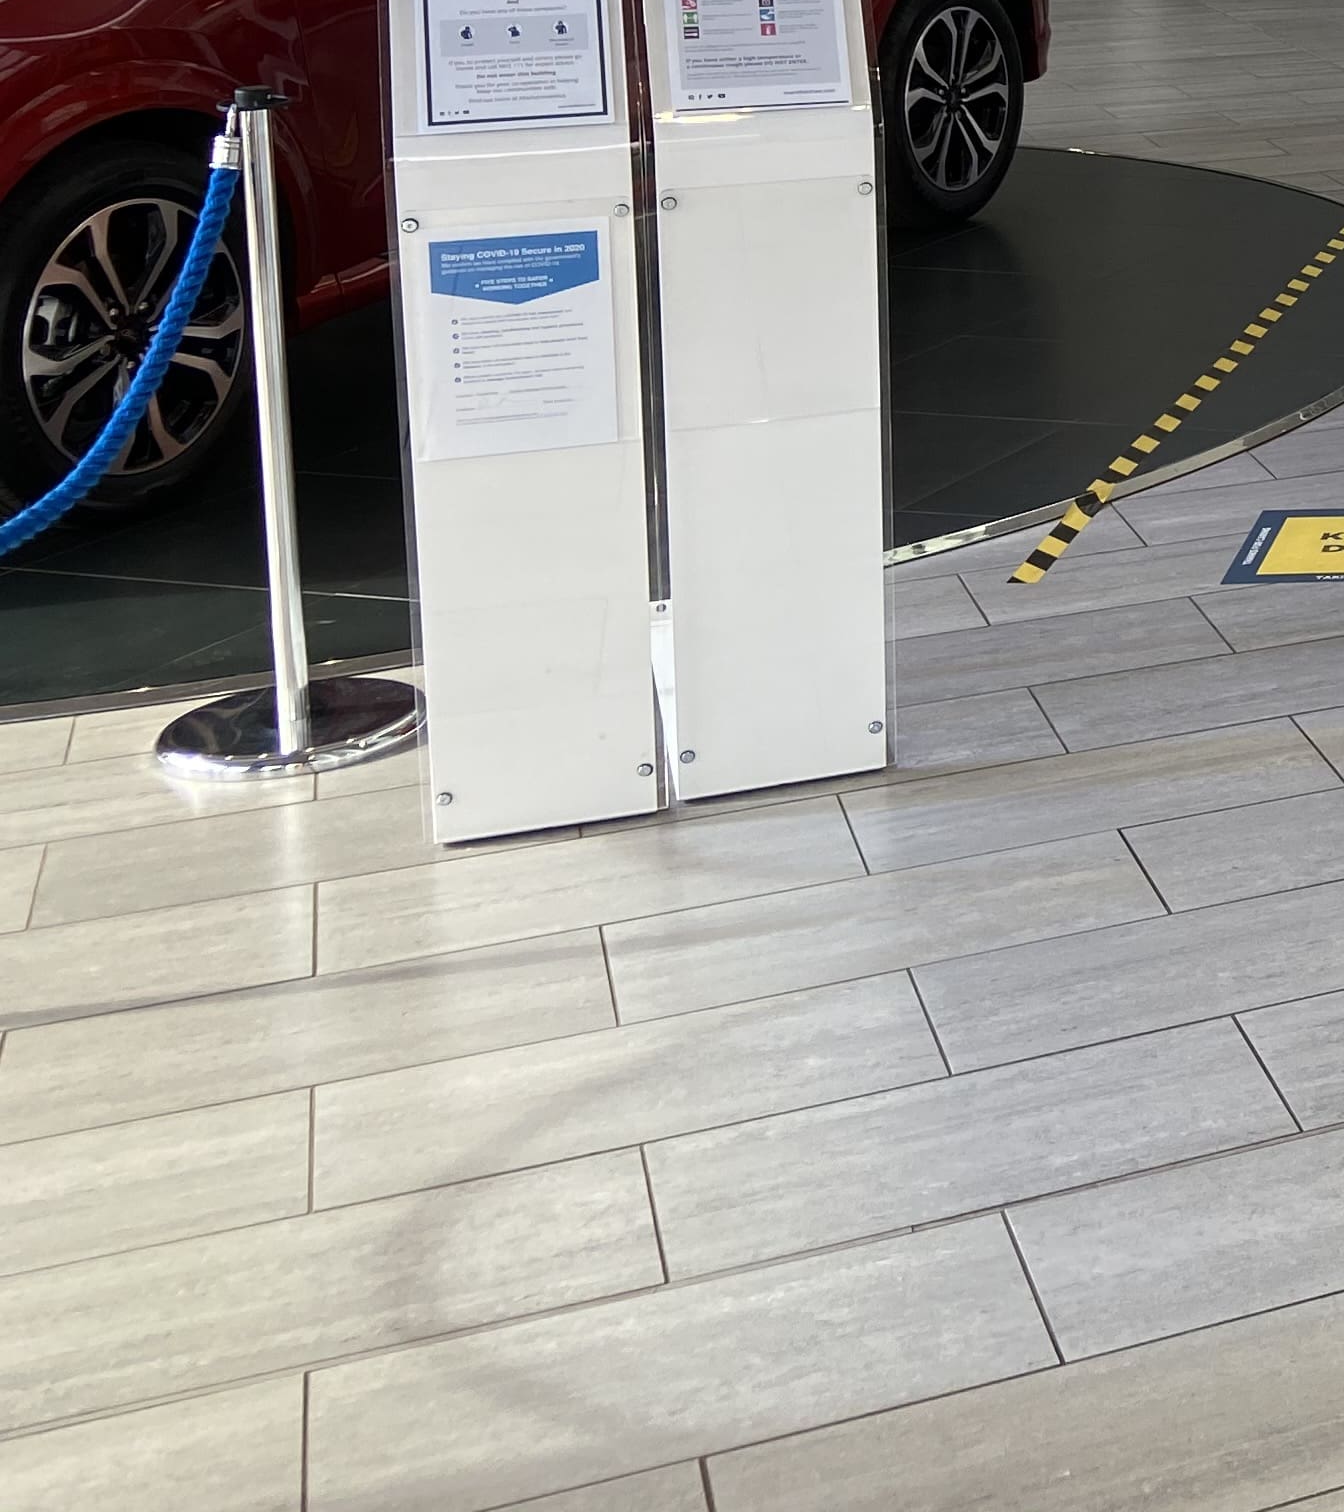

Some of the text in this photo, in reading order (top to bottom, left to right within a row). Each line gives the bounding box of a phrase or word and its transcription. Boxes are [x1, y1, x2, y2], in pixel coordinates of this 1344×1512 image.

[441, 253, 475, 262] Staying
[477, 249, 520, 259] COVID-19
[521, 247, 551, 256] Secure
